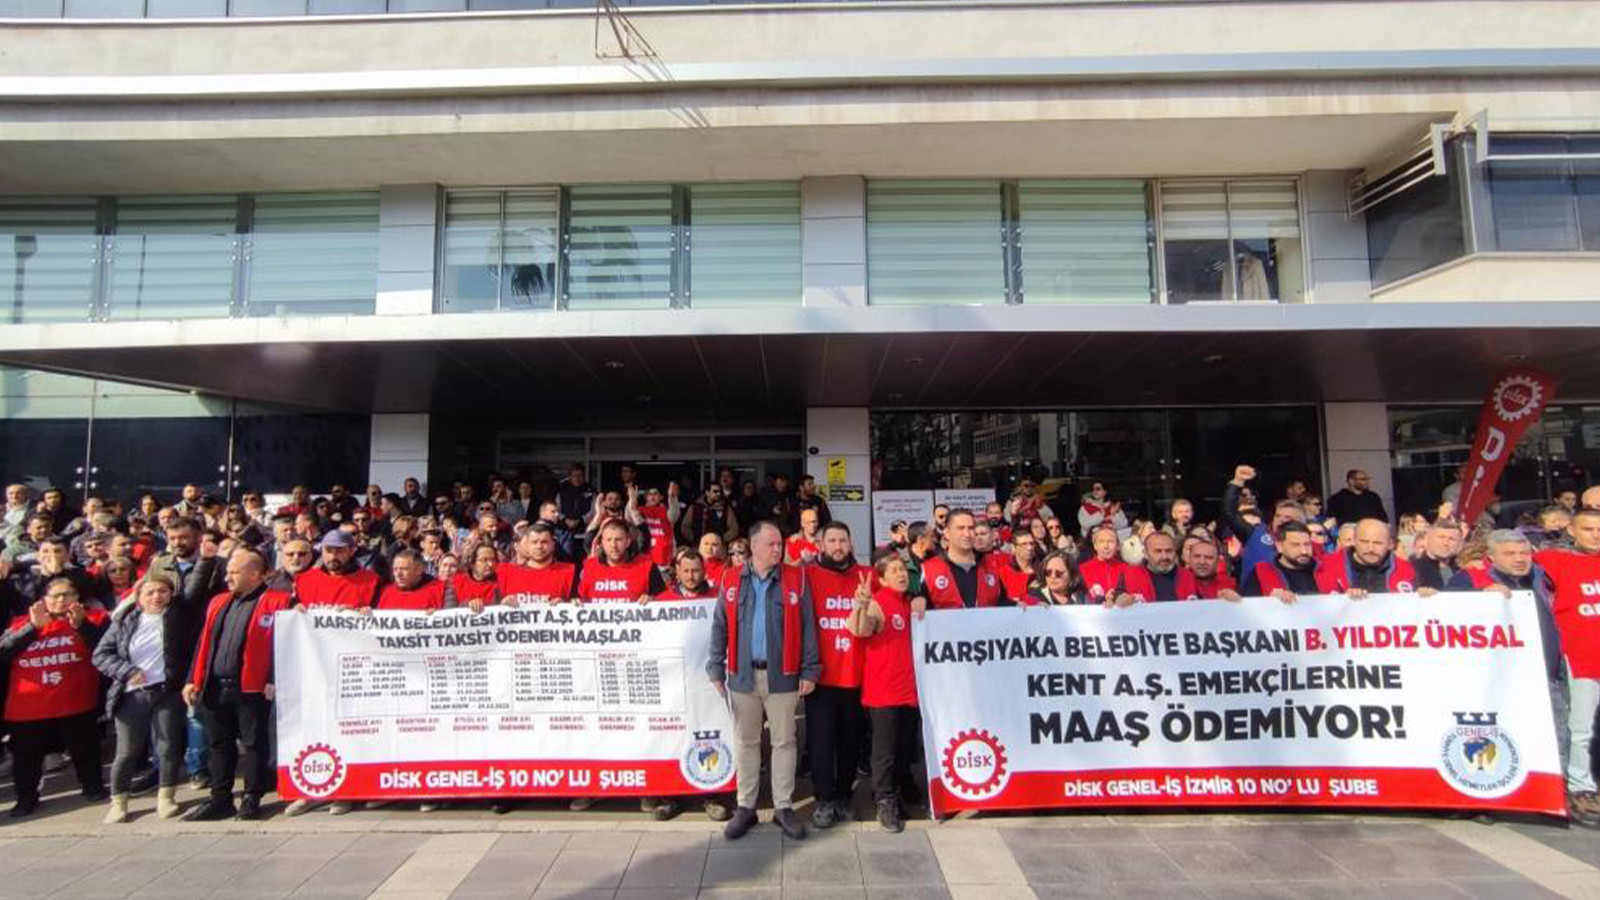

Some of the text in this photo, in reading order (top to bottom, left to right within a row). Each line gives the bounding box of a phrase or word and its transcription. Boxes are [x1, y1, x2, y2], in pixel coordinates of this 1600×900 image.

[594, 580, 628, 592] DİSK
[1579, 579, 1600, 596] Dİ
[314, 614, 401, 630] KARŞIYAKA
[499, 609, 540, 625] KENT
[544, 610, 573, 627] A.Ş.
[577, 606, 708, 626] ÇALIŞANLARINA
[819, 617, 848, 630] GEN
[27, 635, 75, 651] DİSK
[376, 626, 642, 649] TAKSİT TAKSİT ÖDENEN MAAŞLAR
[835, 634, 851, 652] İŞ
[924, 619, 1526, 666] KARŞIYAKA BELEDİYE BAŞKANI B. YILDIZ ÜNSAL
[19, 652, 82, 668] GENEL
[42, 670, 63, 685] İŞ
[1027, 660, 1403, 700] KENT A.Ş. EMEKÇİLERİNE
[1029, 699, 1407, 747] MAAŞ ÖDEMİYOR!
[304, 760, 333, 774] DİSK
[957, 751, 993, 769] DİSK
[379, 768, 422, 789] DİSK
[425, 766, 506, 790] GENEL-İŞ
[509, 770, 529, 787] 10
[569, 770, 591, 787] LU
[599, 769, 647, 790] ŞUBE
[1064, 778, 1103, 798] DİSK
[1107, 778, 1182, 799] GENEL-İŞ
[1186, 775, 1233, 796] İZMİR
[1237, 778, 1257, 796] 10
[1297, 778, 1320, 796] LU
[1329, 778, 1379, 798] ŞUBE
